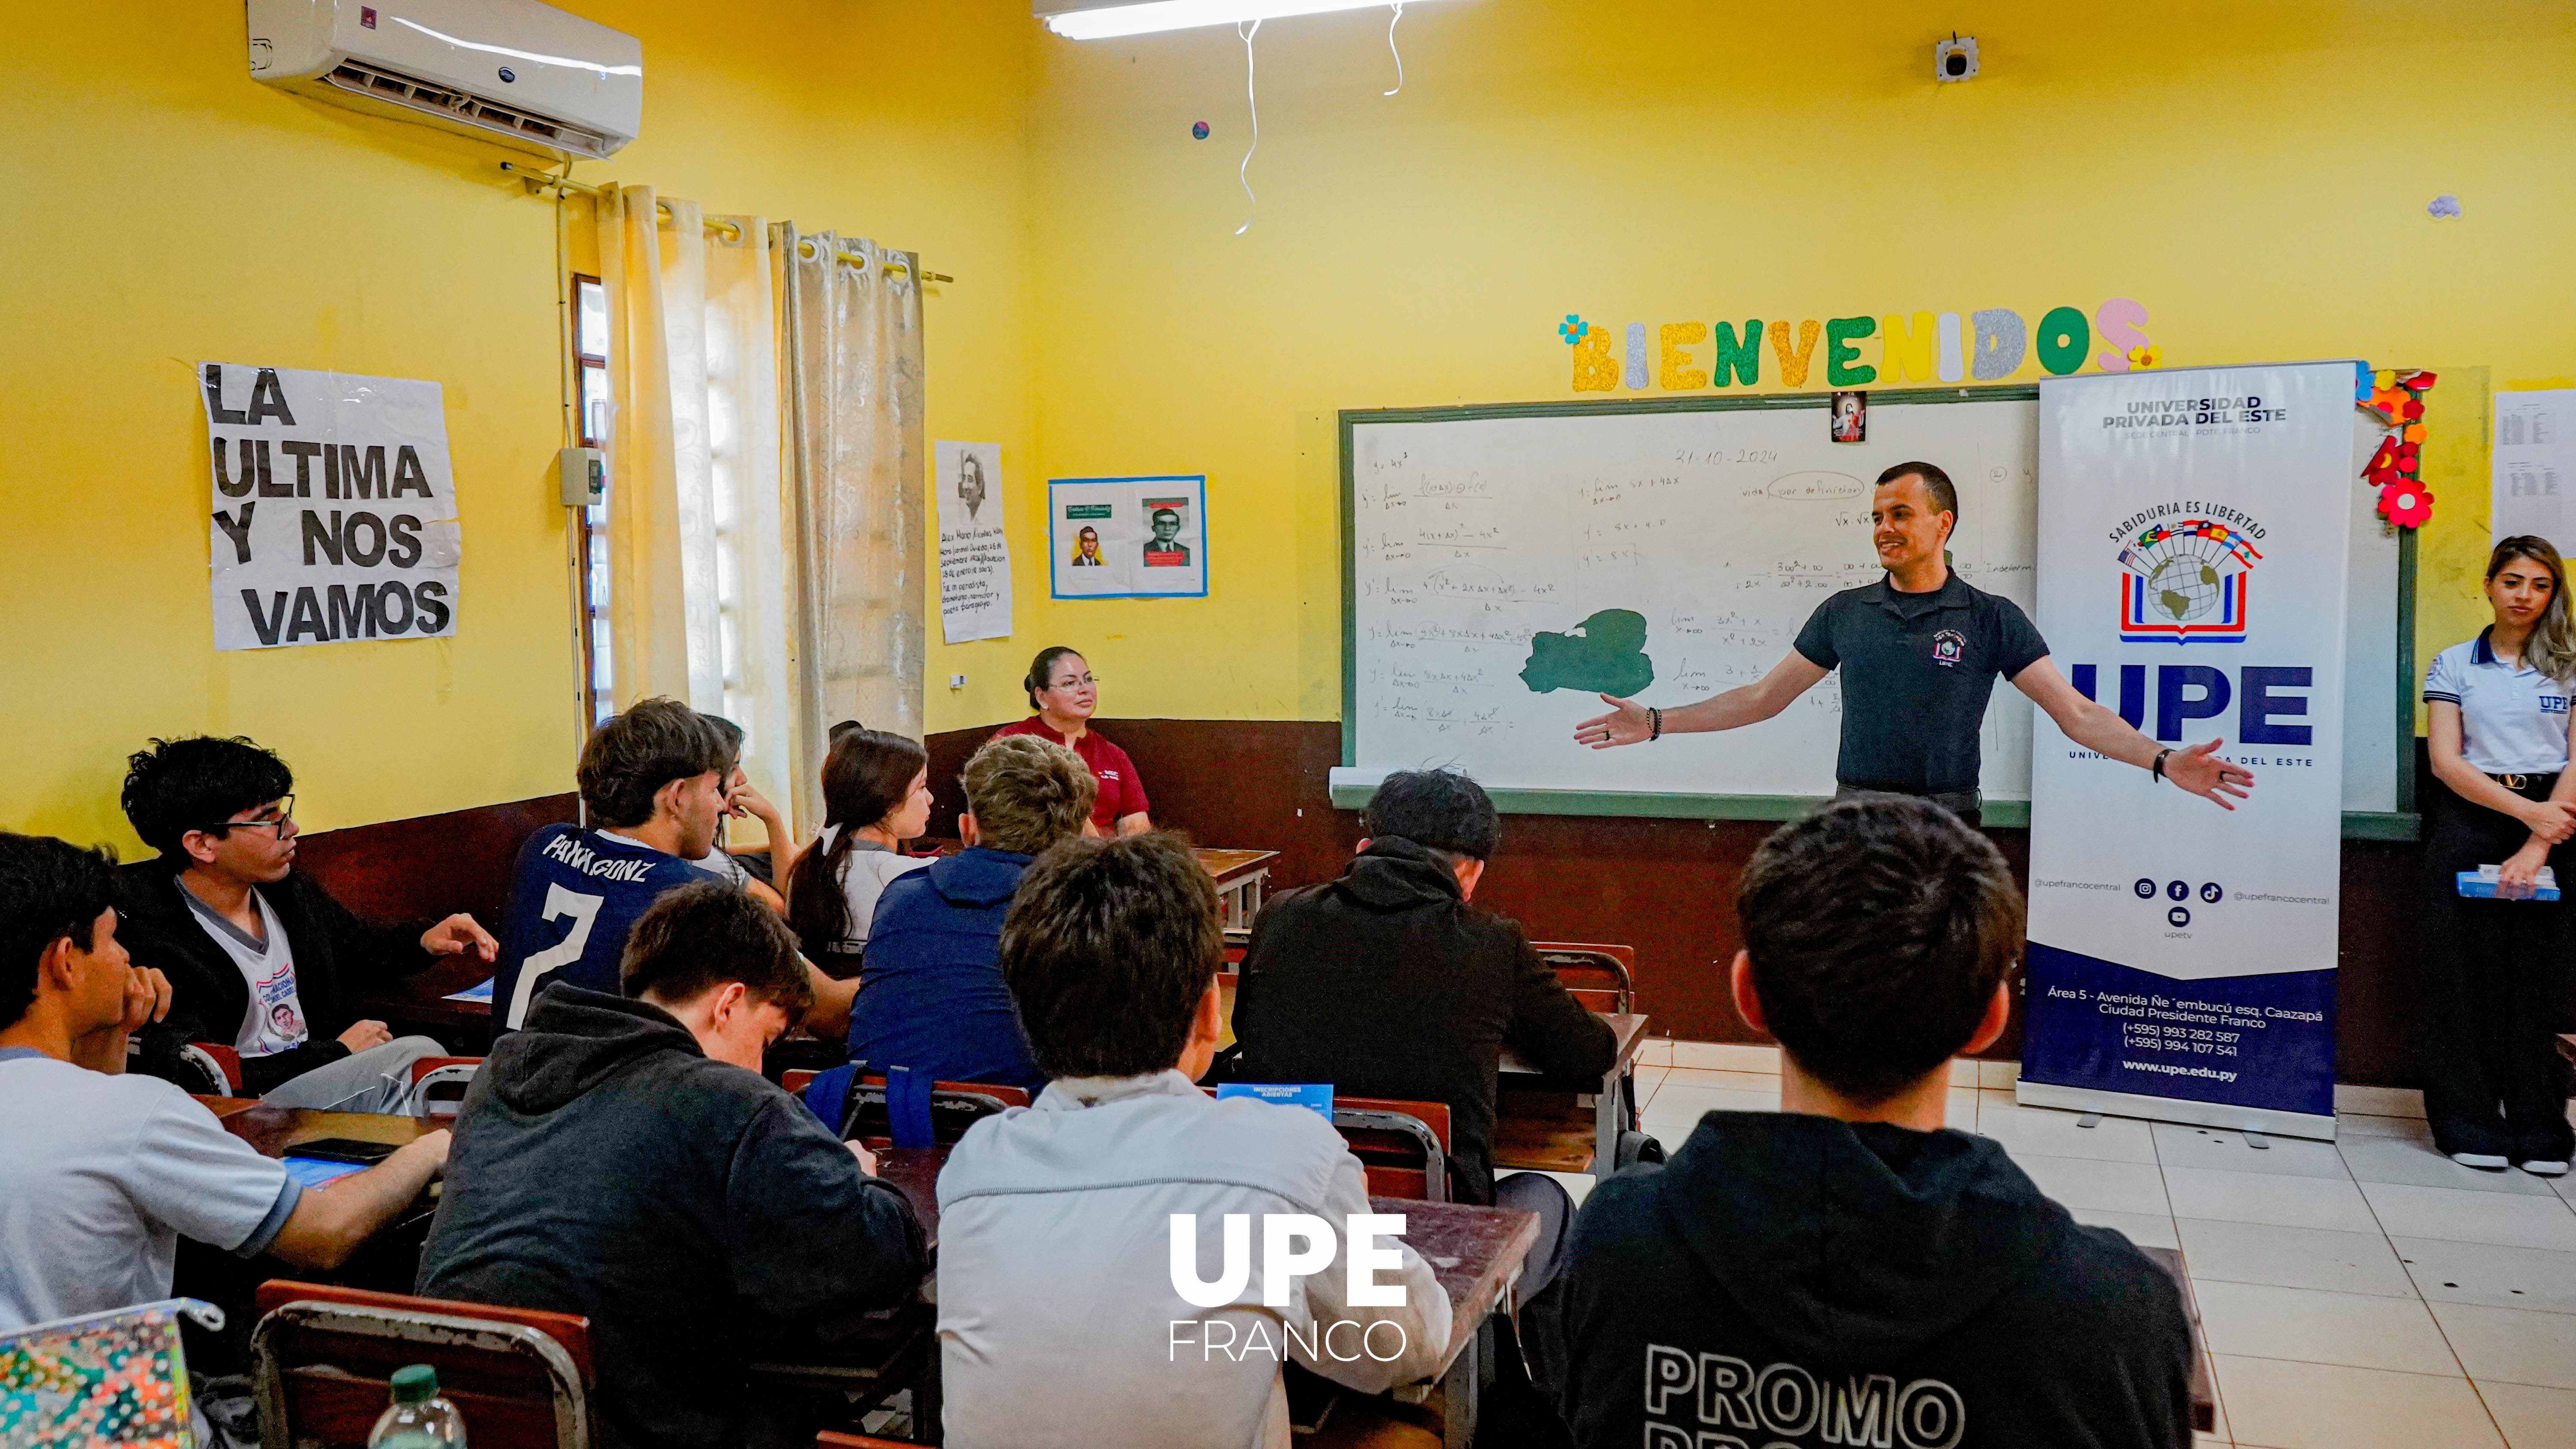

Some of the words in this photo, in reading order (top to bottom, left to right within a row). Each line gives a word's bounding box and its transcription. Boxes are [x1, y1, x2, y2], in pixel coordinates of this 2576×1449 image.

[1572, 298, 2149, 393] BIENVENIDOS
[207, 364, 296, 425] LA
[2127, 397, 2261, 414] UNIVERSIDAD
[2103, 413, 2189, 428] PRIVADA
[2196, 412, 2233, 424] DEL
[2239, 409, 2287, 422] ESTE
[213, 437, 433, 499] ULTIMA
[211, 501, 256, 565] Y
[302, 510, 422, 568] NOS
[2109, 502, 2181, 543] SABIDURIA
[2186, 501, 2201, 513] ES
[2205, 502, 2266, 540] LIBERTAD
[241, 581, 450, 645] VAMOS
[2276, 758, 2313, 767] ESTE
[2034, 878, 2121, 891] @upefrancocentral
[2234, 891, 2330, 905] @upefrancocentral
[2164, 930, 2193, 939] upetv
[506, 882, 604, 1030] 7
[2047, 985, 2076, 999] Área
[2079, 989, 2087, 1000] 5
[2097, 991, 2148, 1006] Avenida
[2235, 1006, 2262, 1018] esq.
[2264, 1006, 2323, 1022] Caazapá
[2099, 1003, 2145, 1017] Ciudad
[2148, 1008, 2218, 1024] Presidente
[2221, 1015, 2266, 1028] Franco
[2123, 1022, 2160, 1038] (+595)
[2163, 1026, 2187, 1038] 993
[2189, 1029, 2213, 1040] 282
[2216, 1031, 2240, 1043] 587
[2124, 1035, 2161, 1052] (+595)
[2164, 1040, 2190, 1052] 994
[2192, 1043, 2214, 1053] 107
[2216, 1045, 2237, 1057] 541
[2122, 1061, 2238, 1083] www.upe.edu.py
[1645, 1343, 1966, 1449] PROMO
